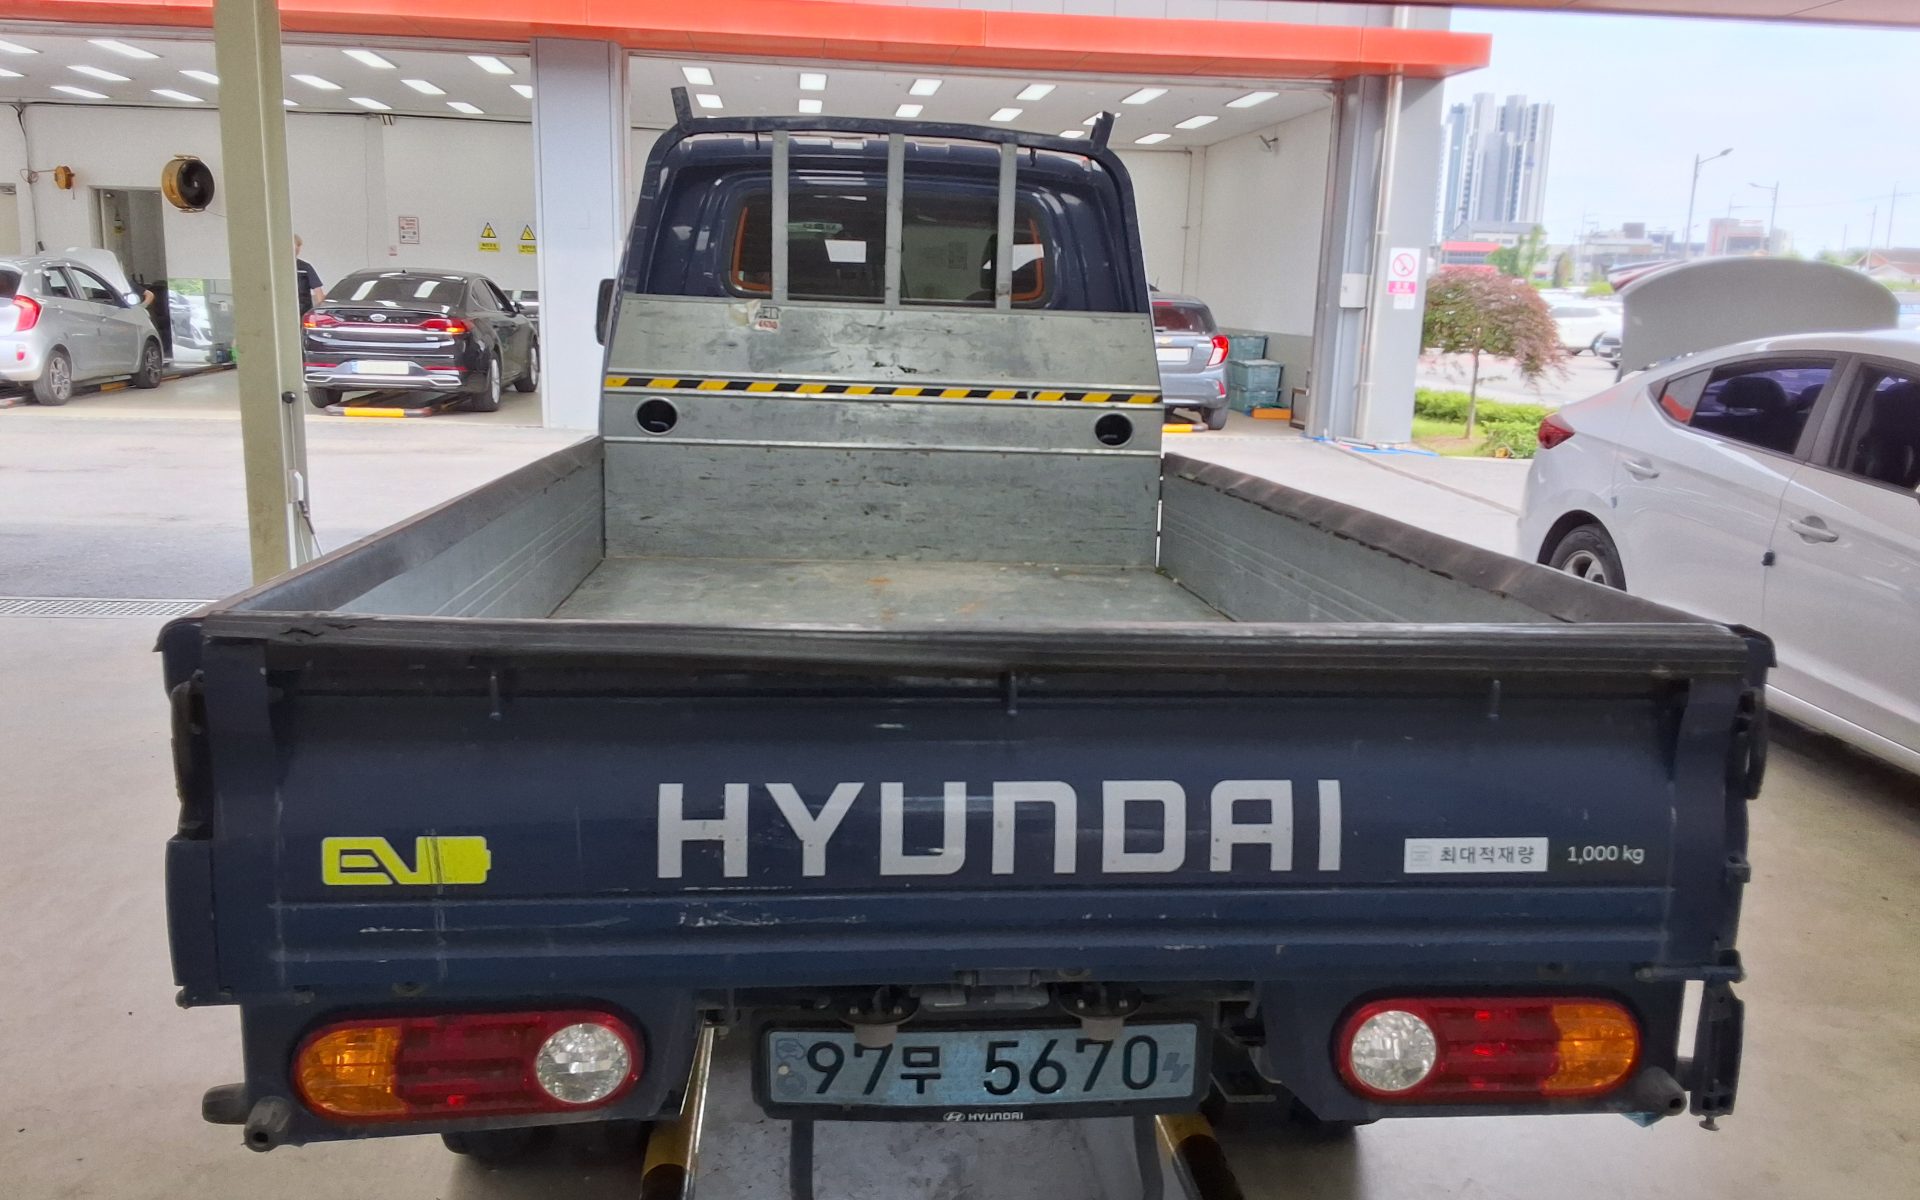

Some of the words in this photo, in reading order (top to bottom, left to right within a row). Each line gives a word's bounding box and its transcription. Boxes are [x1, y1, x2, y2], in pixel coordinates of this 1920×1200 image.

[657, 779, 1341, 879] HYUNDAI
[322, 836, 490, 885] EV
[1440, 845, 1535, 865] 최대적재량
[1567, 845, 1618, 865] 1,000
[1621, 844, 1645, 865] kg
[806, 1041, 942, 1096] 97무
[983, 1035, 1159, 1096] 5670
[968, 1111, 1024, 1121] HYUNDAI
